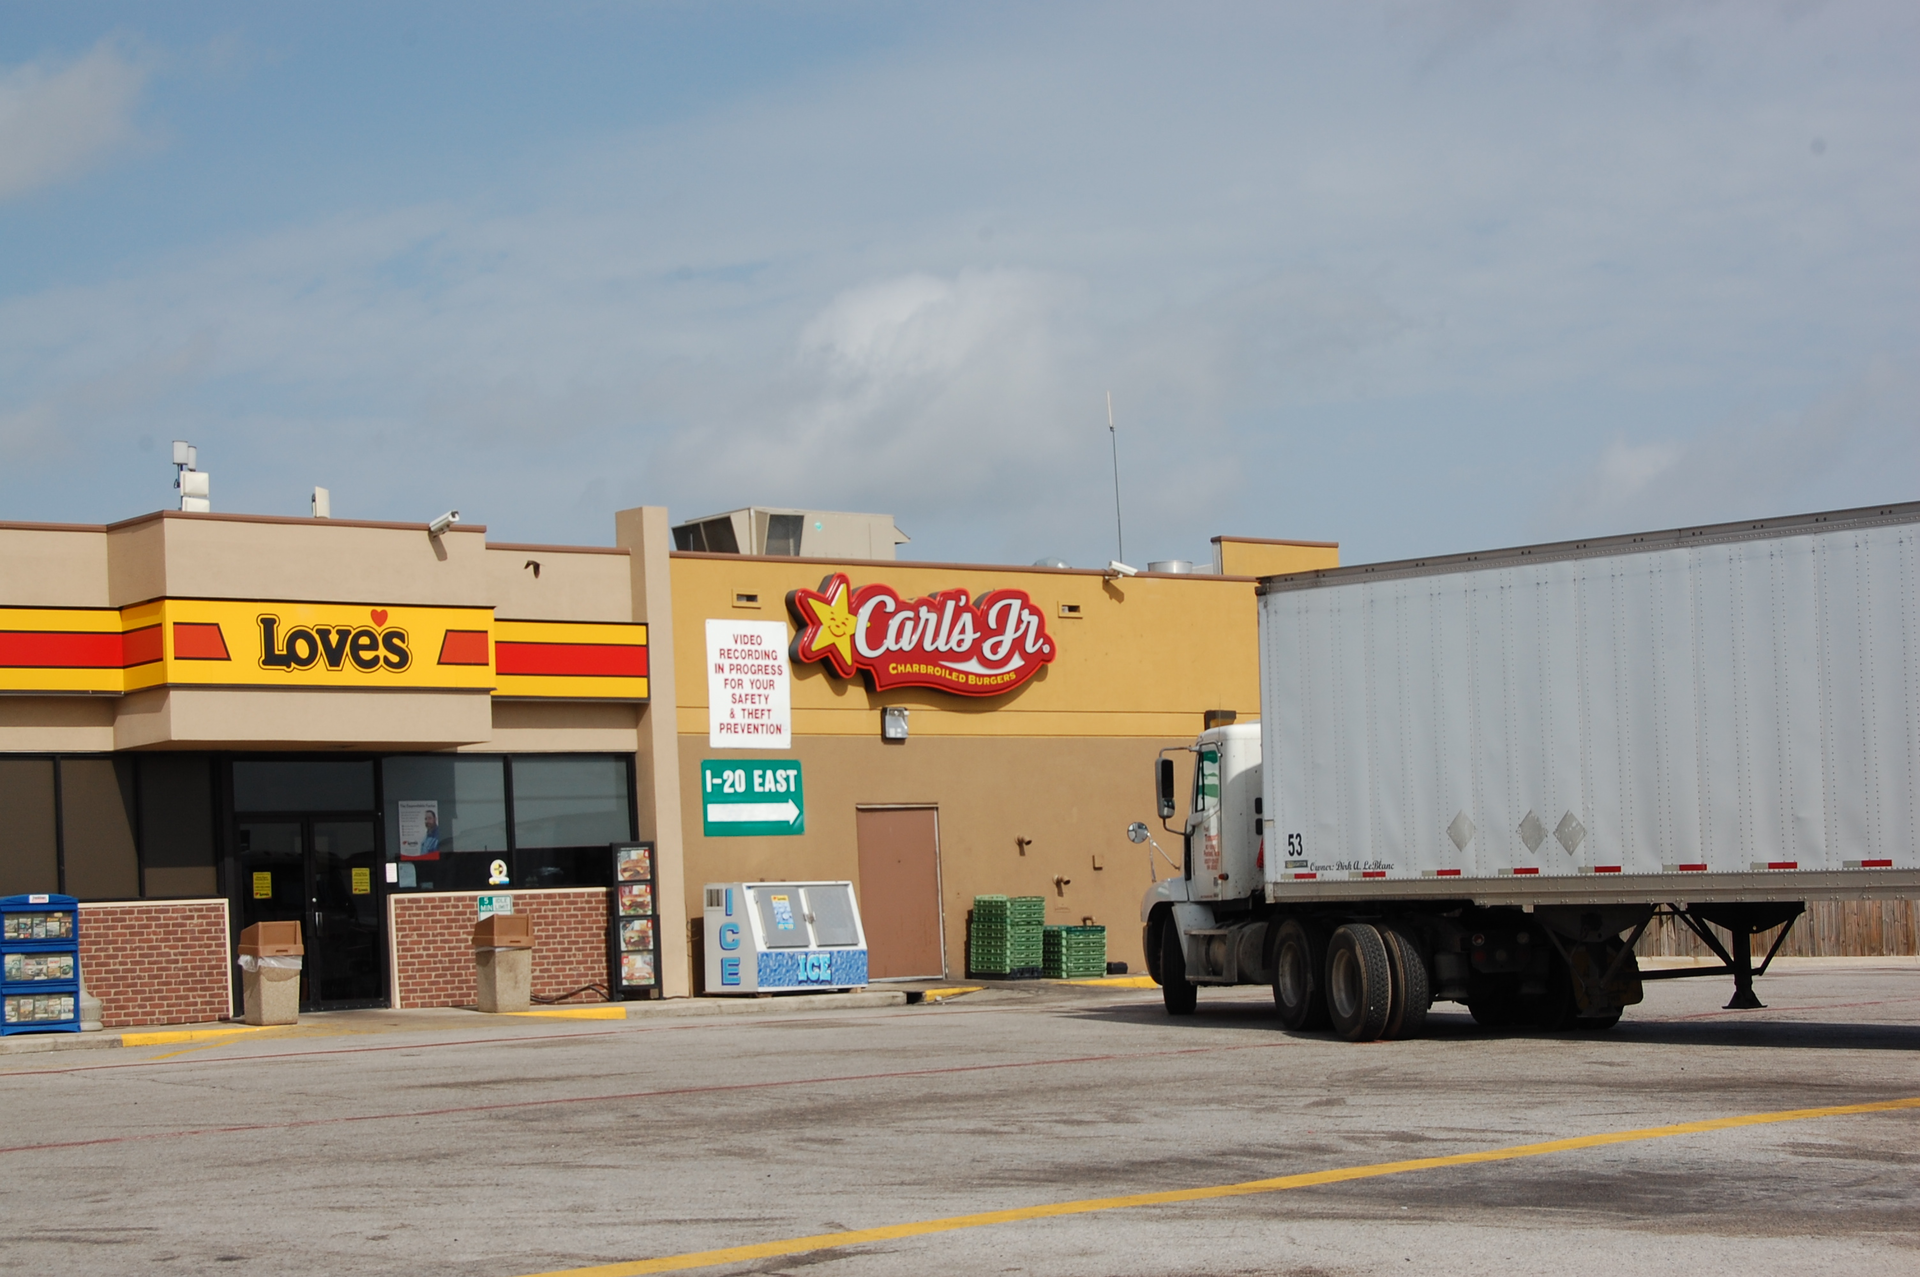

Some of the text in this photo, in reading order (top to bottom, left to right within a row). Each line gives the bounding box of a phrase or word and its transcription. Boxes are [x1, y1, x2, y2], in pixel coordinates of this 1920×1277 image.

[854, 594, 982, 659] Carl's
[732, 634, 763, 646] VIDEO
[719, 648, 778, 661] RECORDING
[714, 663, 783, 676] IN PROGRESS
[888, 662, 1017, 686] CHARBROILED BURGERS
[723, 678, 775, 690] FOR YOUR
[731, 693, 770, 705] SAFETY
[729, 708, 772, 720] & THEFT
[719, 723, 782, 735] PREVENTION
[705, 768, 798, 794] I-20 EAST
[1287, 832, 1304, 857] 53
[1309, 861, 1335, 872] Owner:
[719, 887, 741, 986] ICE
[797, 952, 832, 984] ICE
